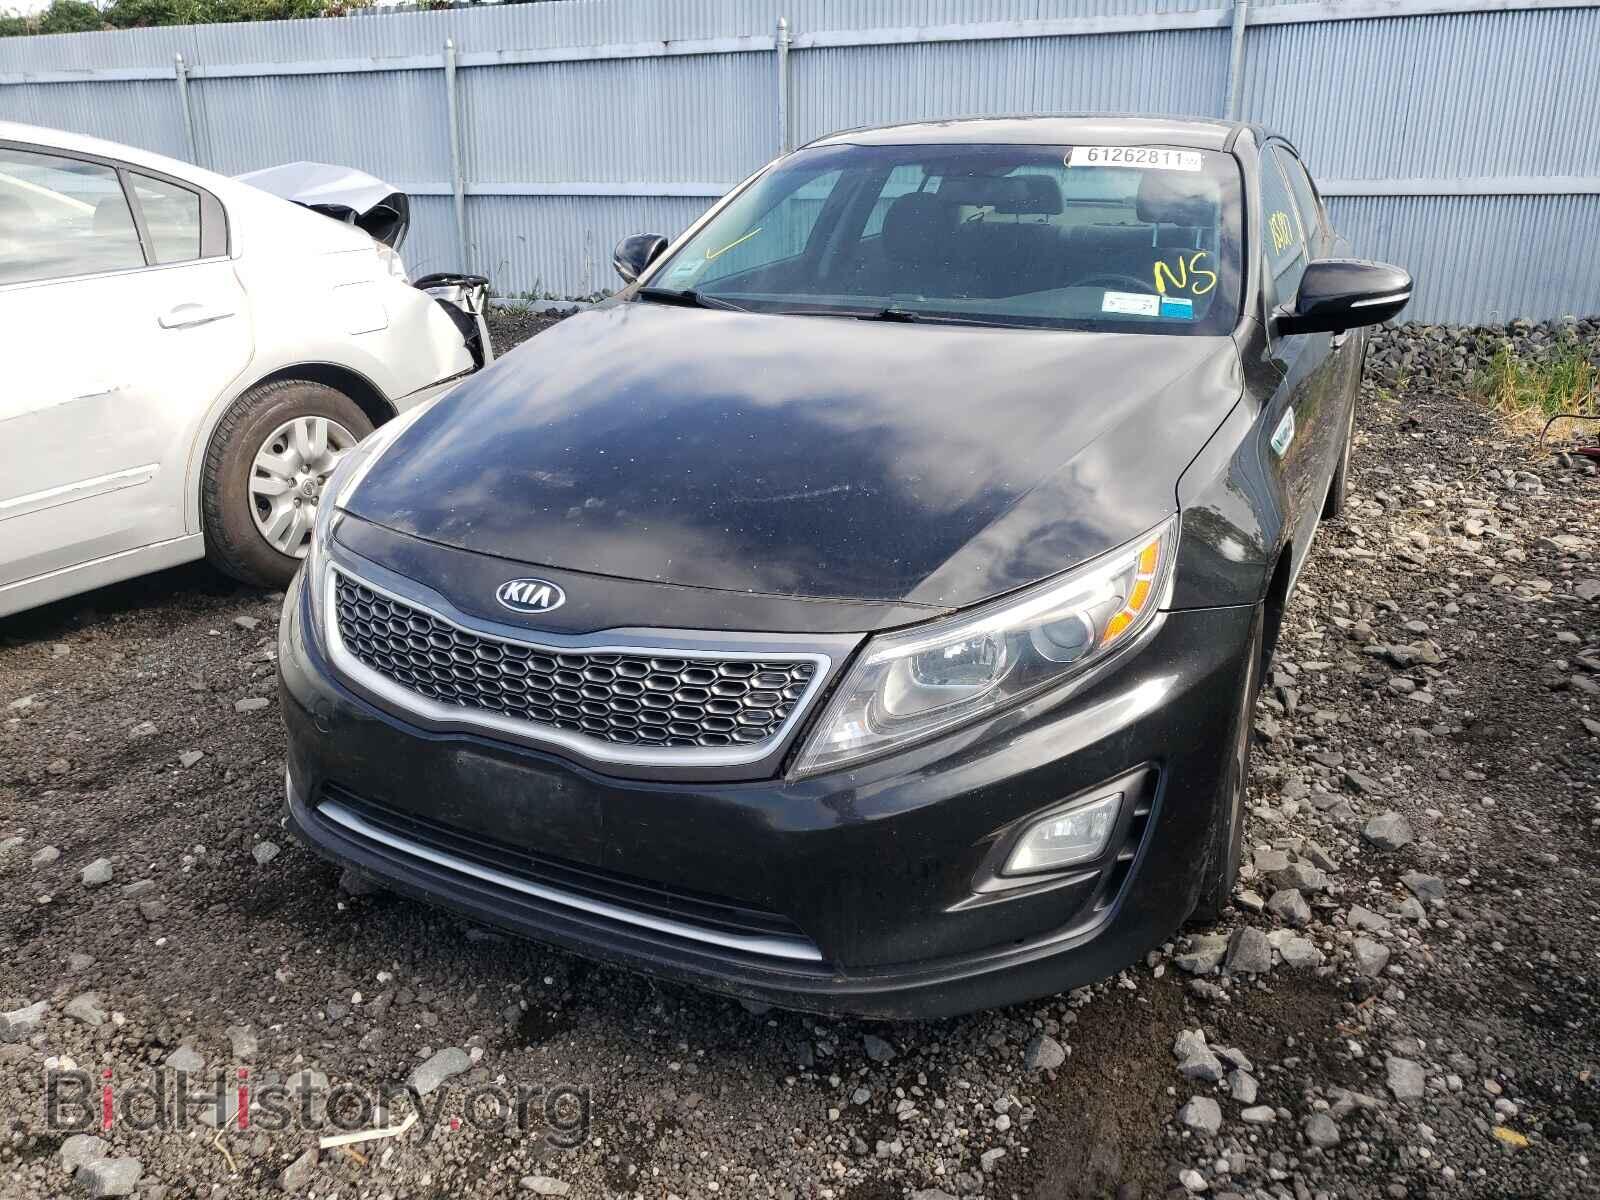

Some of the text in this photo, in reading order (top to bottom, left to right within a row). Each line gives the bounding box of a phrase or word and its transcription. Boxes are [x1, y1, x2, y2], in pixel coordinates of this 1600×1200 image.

[1087, 147, 1182, 166] 61262811
[1154, 252, 1216, 294] NS
[503, 582, 551, 608] KIA
